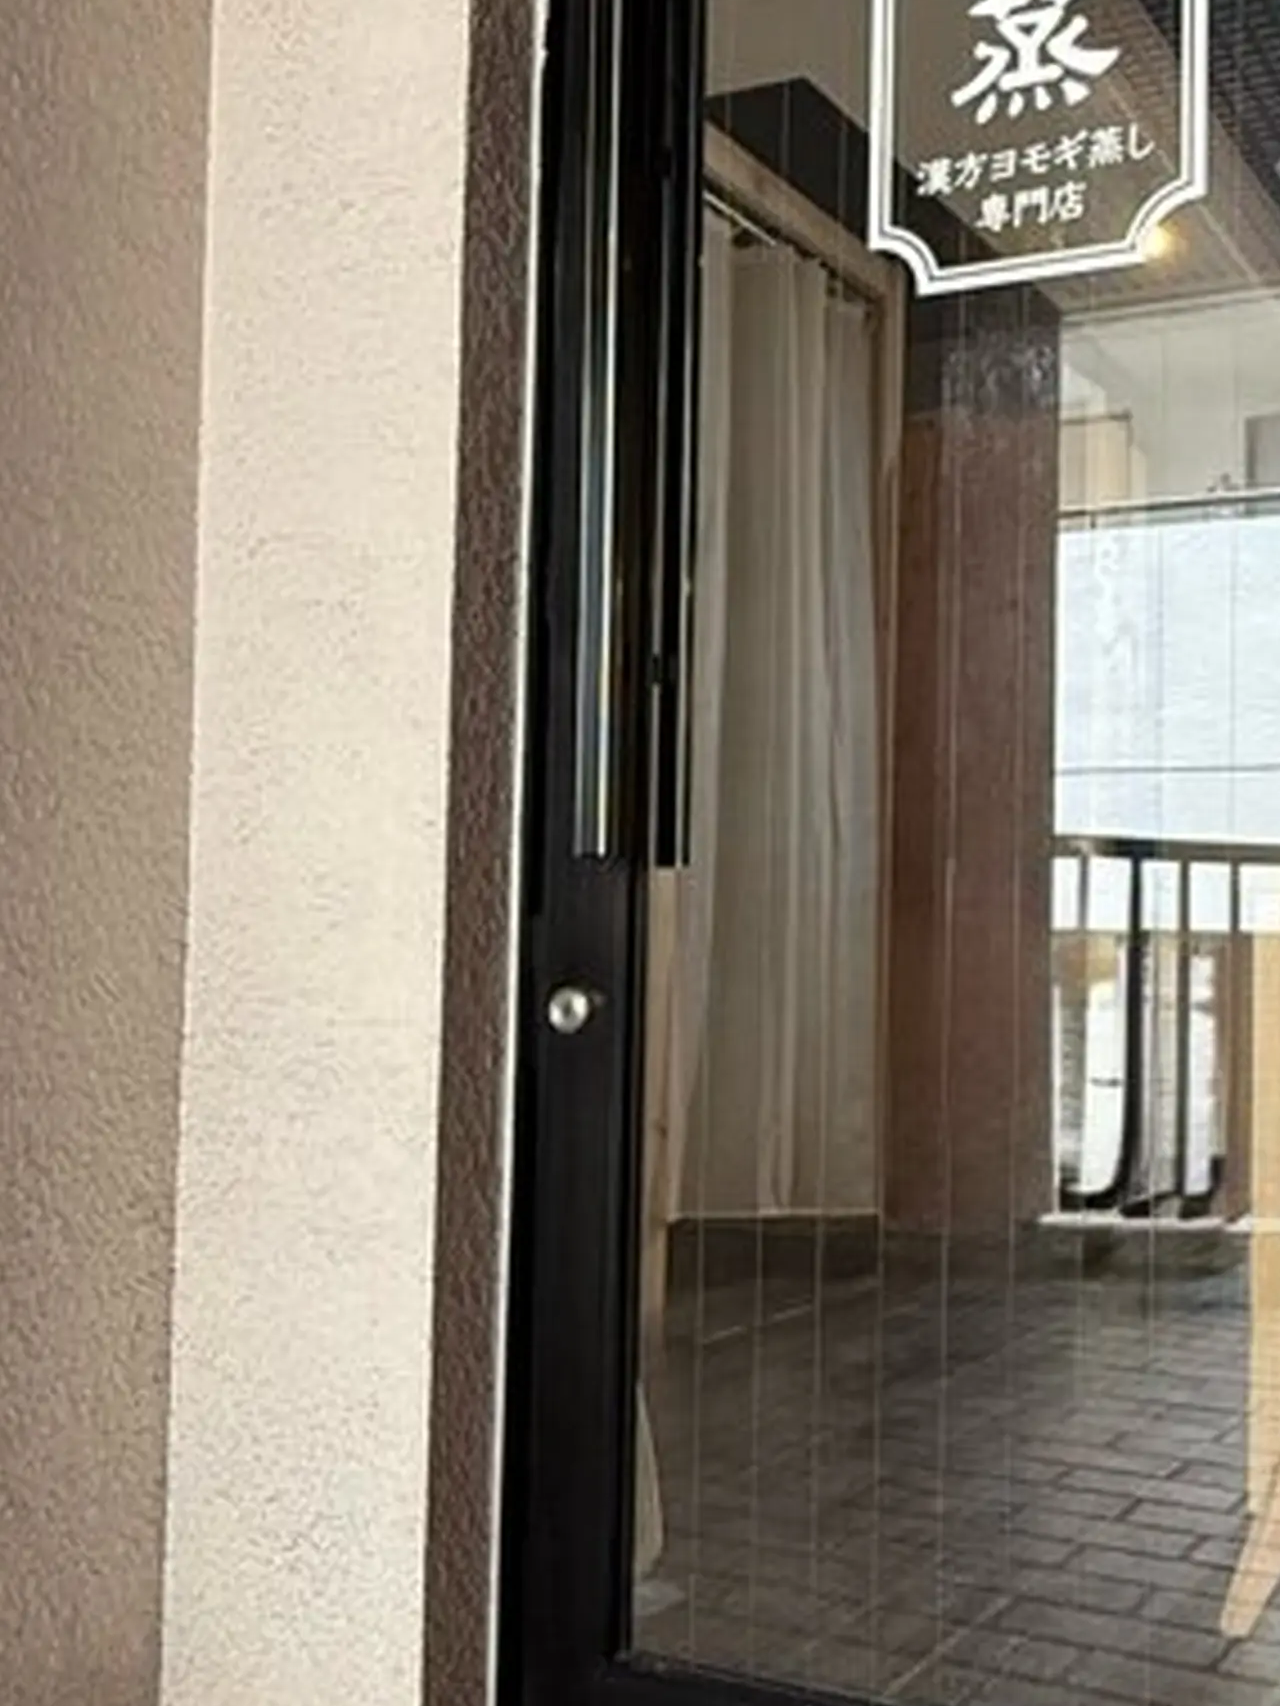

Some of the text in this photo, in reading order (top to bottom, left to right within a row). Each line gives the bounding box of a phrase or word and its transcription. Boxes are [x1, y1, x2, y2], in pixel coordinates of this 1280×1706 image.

[916, 122, 1155, 195] 漢方ヨモギ蒸し
[976, 181, 1087, 232] 専門店
